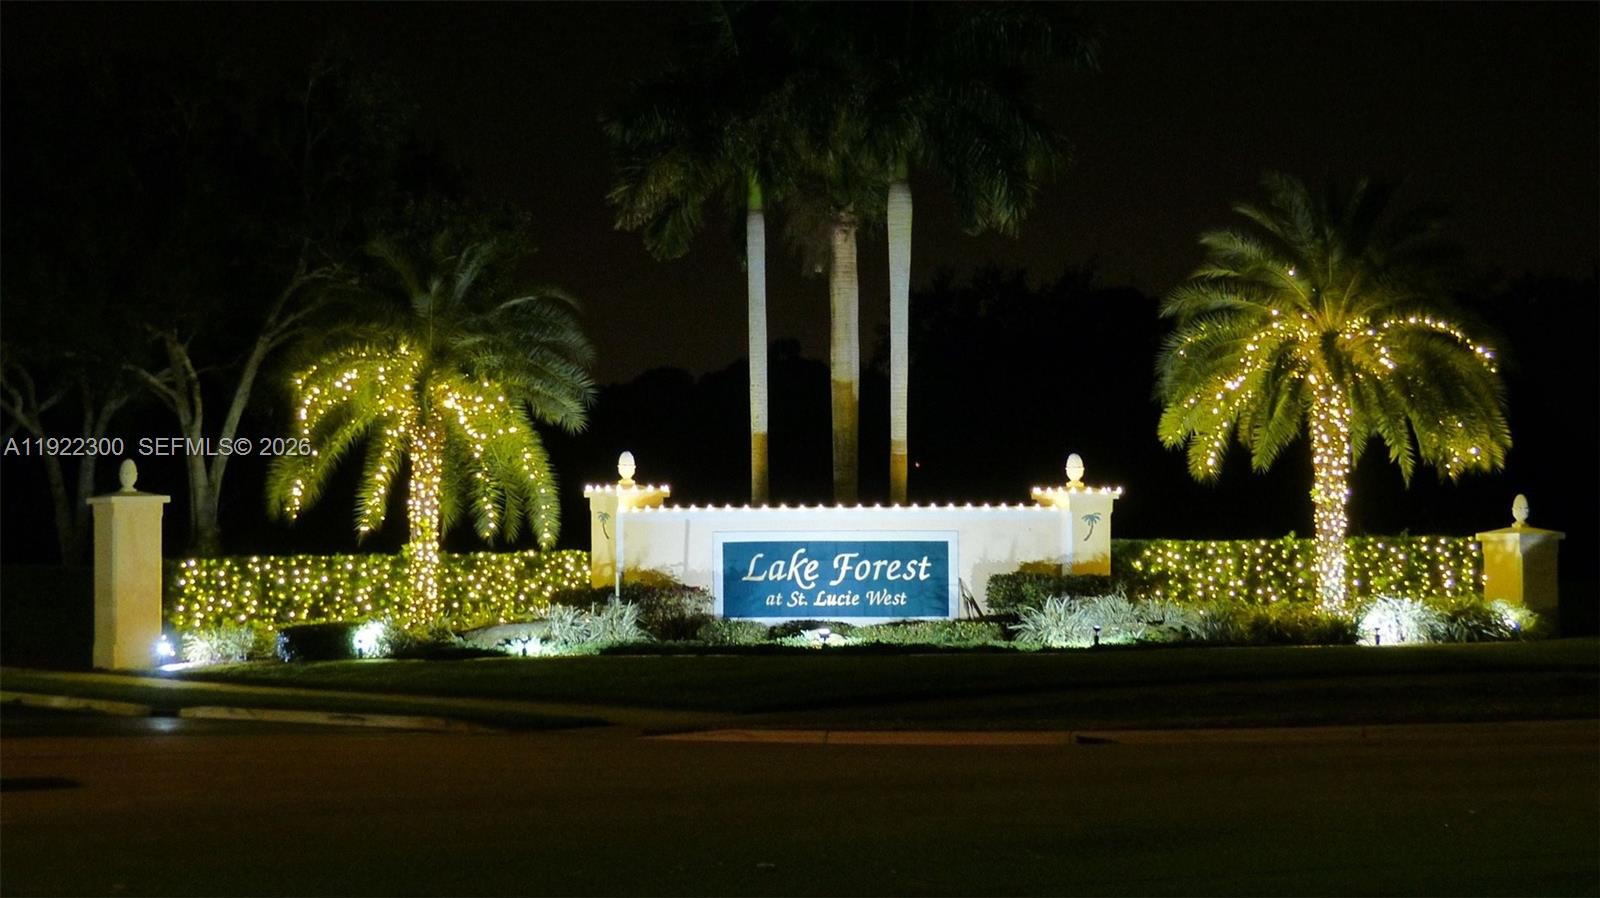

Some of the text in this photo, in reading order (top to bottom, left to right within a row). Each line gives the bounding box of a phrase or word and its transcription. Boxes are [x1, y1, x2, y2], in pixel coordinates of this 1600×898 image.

[742, 548, 932, 590] Lake Forest
[766, 589, 908, 608] at St. Lucie West
